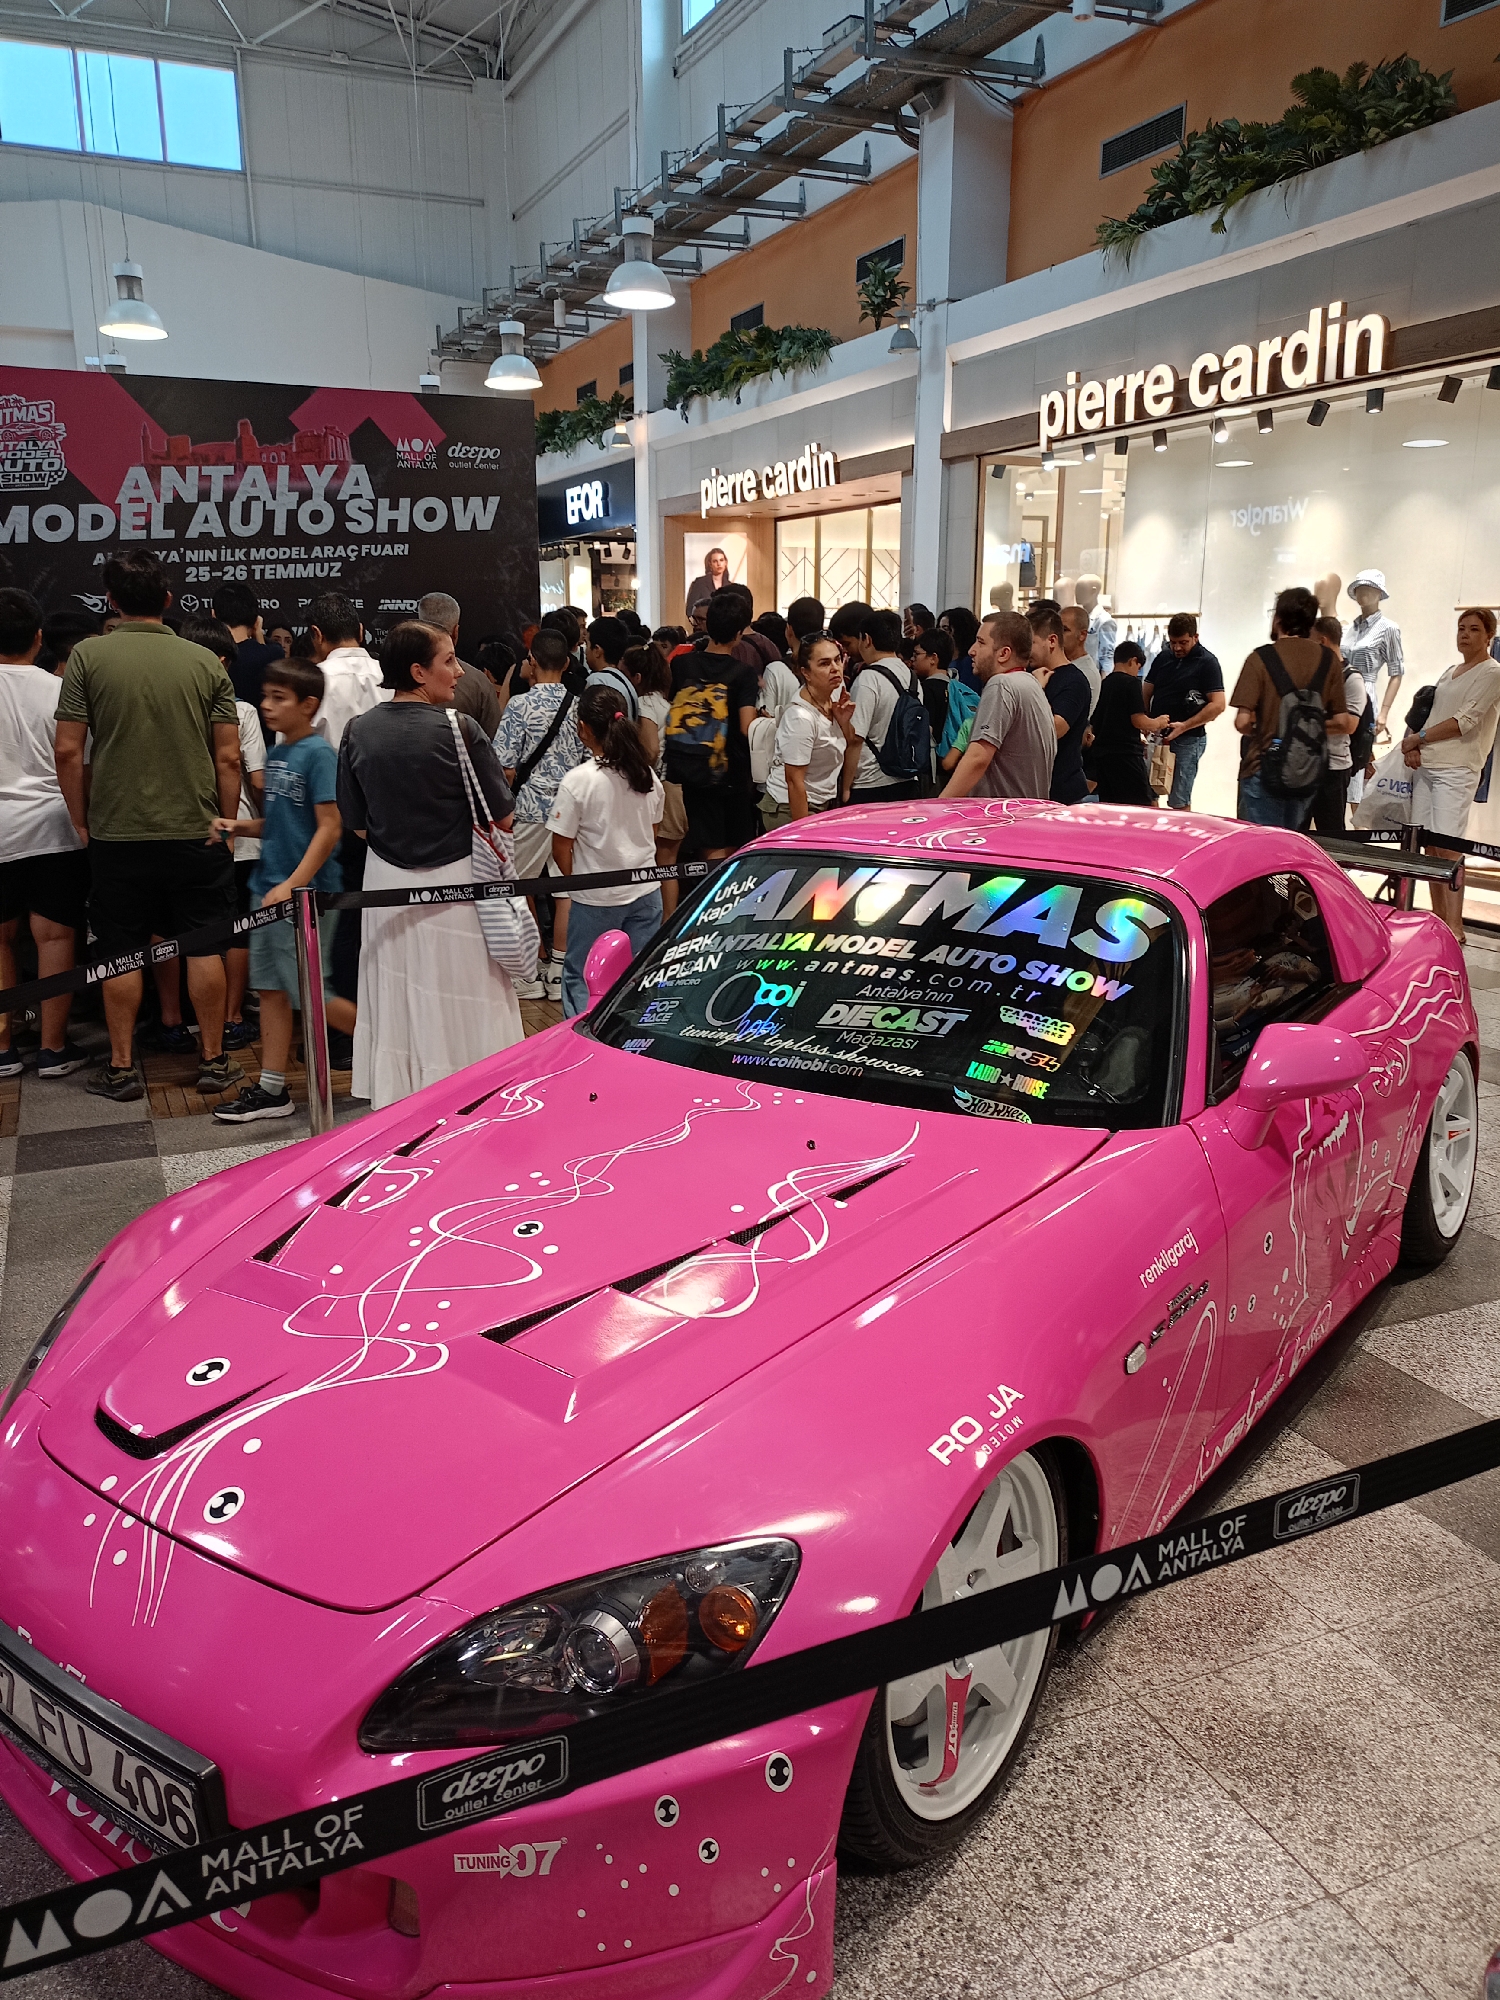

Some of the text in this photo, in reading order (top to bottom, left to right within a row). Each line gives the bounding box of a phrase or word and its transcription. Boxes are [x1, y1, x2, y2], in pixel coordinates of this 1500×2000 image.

[1040, 301, 1386, 452] pierre cardin
[0, 403, 51, 424] TMAS
[0, 440, 57, 450] TALYA
[396, 452, 437, 462] MALL OF
[1, 473, 47, 483] SHOW
[397, 461, 438, 470] ANTALYA
[449, 461, 500, 470] outlet center
[115, 464, 376, 503] ANTALYA
[700, 443, 836, 519] pierre cardin
[185, 498, 335, 539] AUTO
[345, 495, 500, 535] SHOW
[565, 480, 604, 525] EFOR
[250, 547, 308, 561] MODEL
[310, 544, 359, 562] ARAÇ
[361, 544, 409, 557] FUARI
[185, 562, 342, 583] 25-26 TEMMUZ
[443, 893, 475, 901] ANTALYA
[712, 867, 1172, 963] ANTMAS
[115, 956, 134, 967] MALL
[134, 951, 144, 961] OF
[660, 931, 719, 965] BERK
[117, 959, 145, 974] ANTALYA
[638, 952, 723, 992] KAPLAN
[702, 932, 1134, 1002] ANTALYA MODEL AUTO SHOW
[638, 1013, 674, 1023] RACE
[645, 1000, 680, 1014] POP
[816, 1003, 970, 1035] DIECAST
[621, 1038, 656, 1049] MINI
[1028, 1024, 1065, 1039] WORKS
[731, 1052, 864, 1078] www.coihobi.com
[1010, 1073, 1051, 1100] HOUSE
[1157, 1514, 1248, 1563] MALL OF
[1157, 1536, 1245, 1581] ANTALYA
[29, 1688, 93, 1777] FU
[112, 1750, 197, 1846] 406
[444, 1778, 543, 1820] outlet center
[201, 1804, 365, 1878] MALL OF
[205, 1831, 365, 1900] ANTALYA
[456, 1841, 562, 1877] TUNING 07
